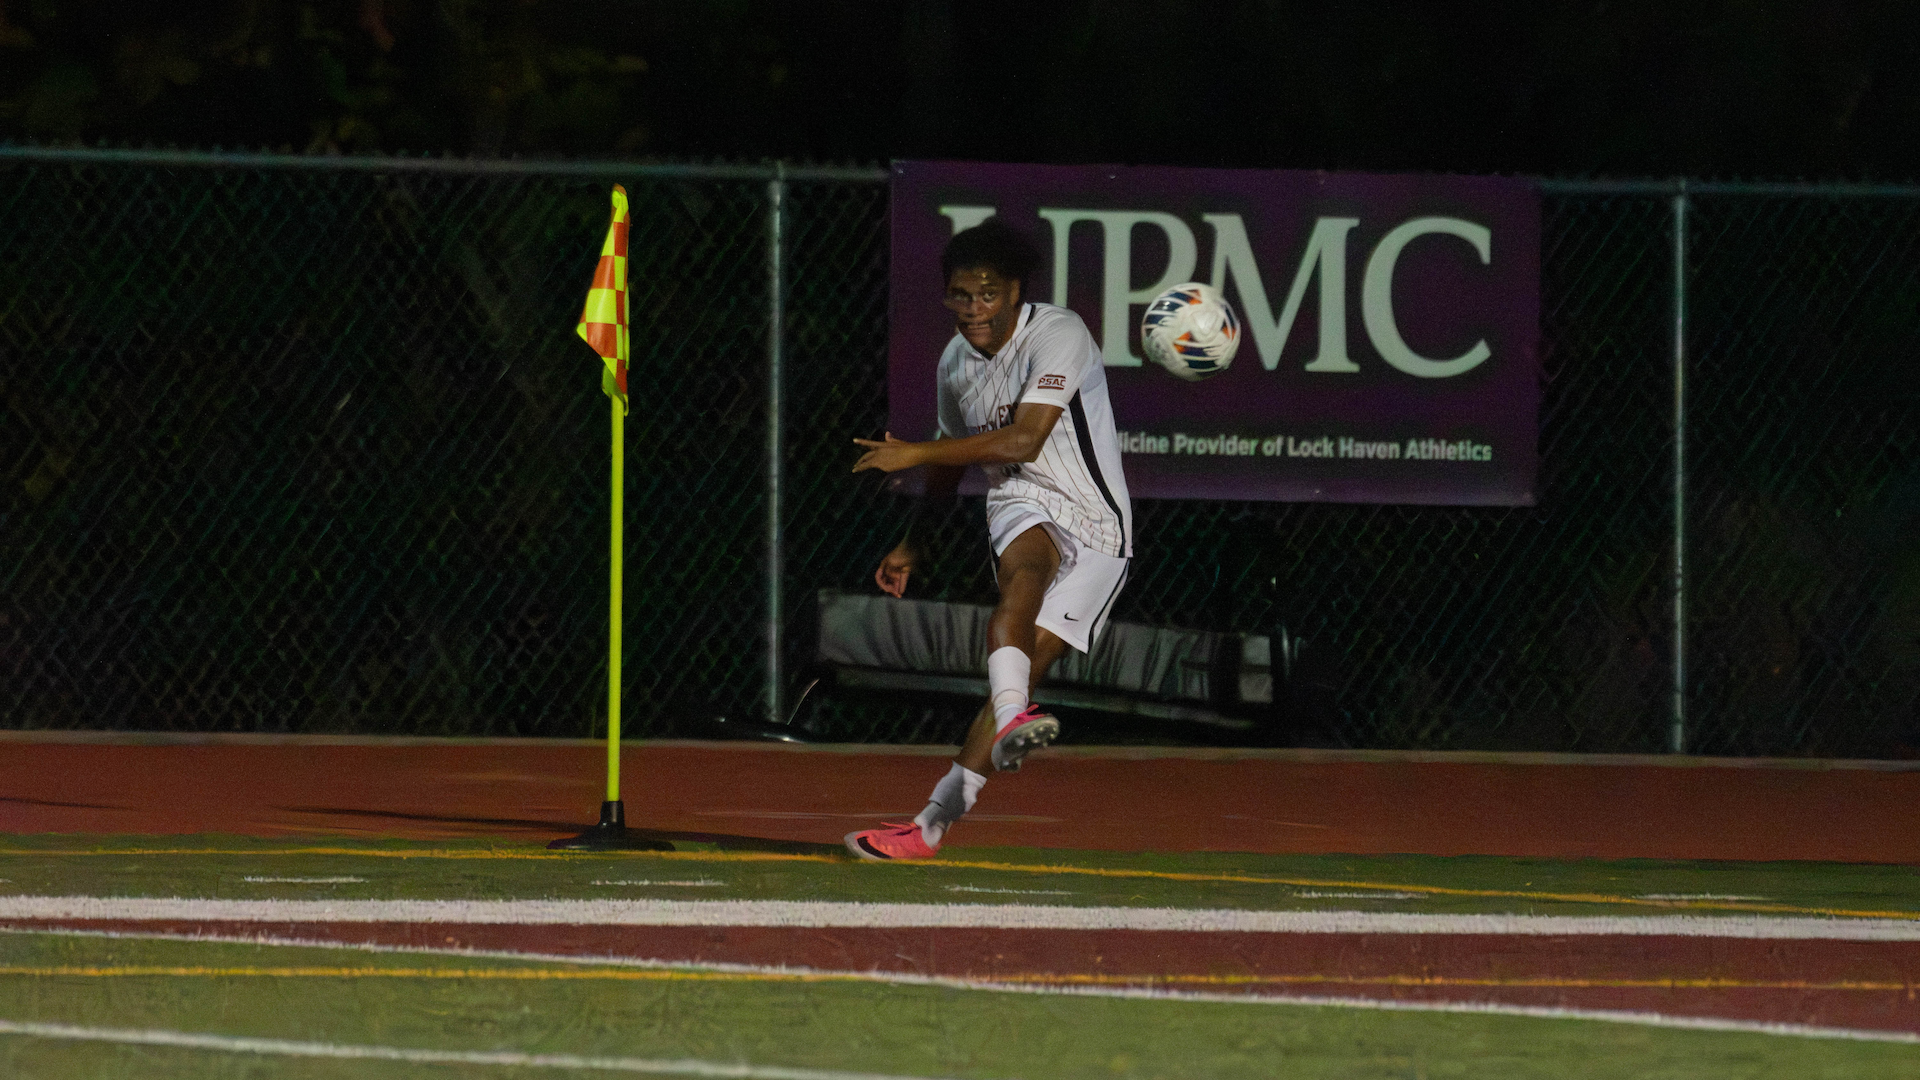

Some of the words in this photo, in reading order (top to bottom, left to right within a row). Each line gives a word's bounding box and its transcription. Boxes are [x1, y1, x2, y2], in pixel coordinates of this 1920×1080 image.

[1038, 377, 1066, 388] PSAC
[1173, 433, 1260, 456] Provider
[1261, 436, 1284, 457] of
[1287, 436, 1335, 458] Lock
[1339, 437, 1400, 460] Haven
[1404, 438, 1492, 461] Athletics
